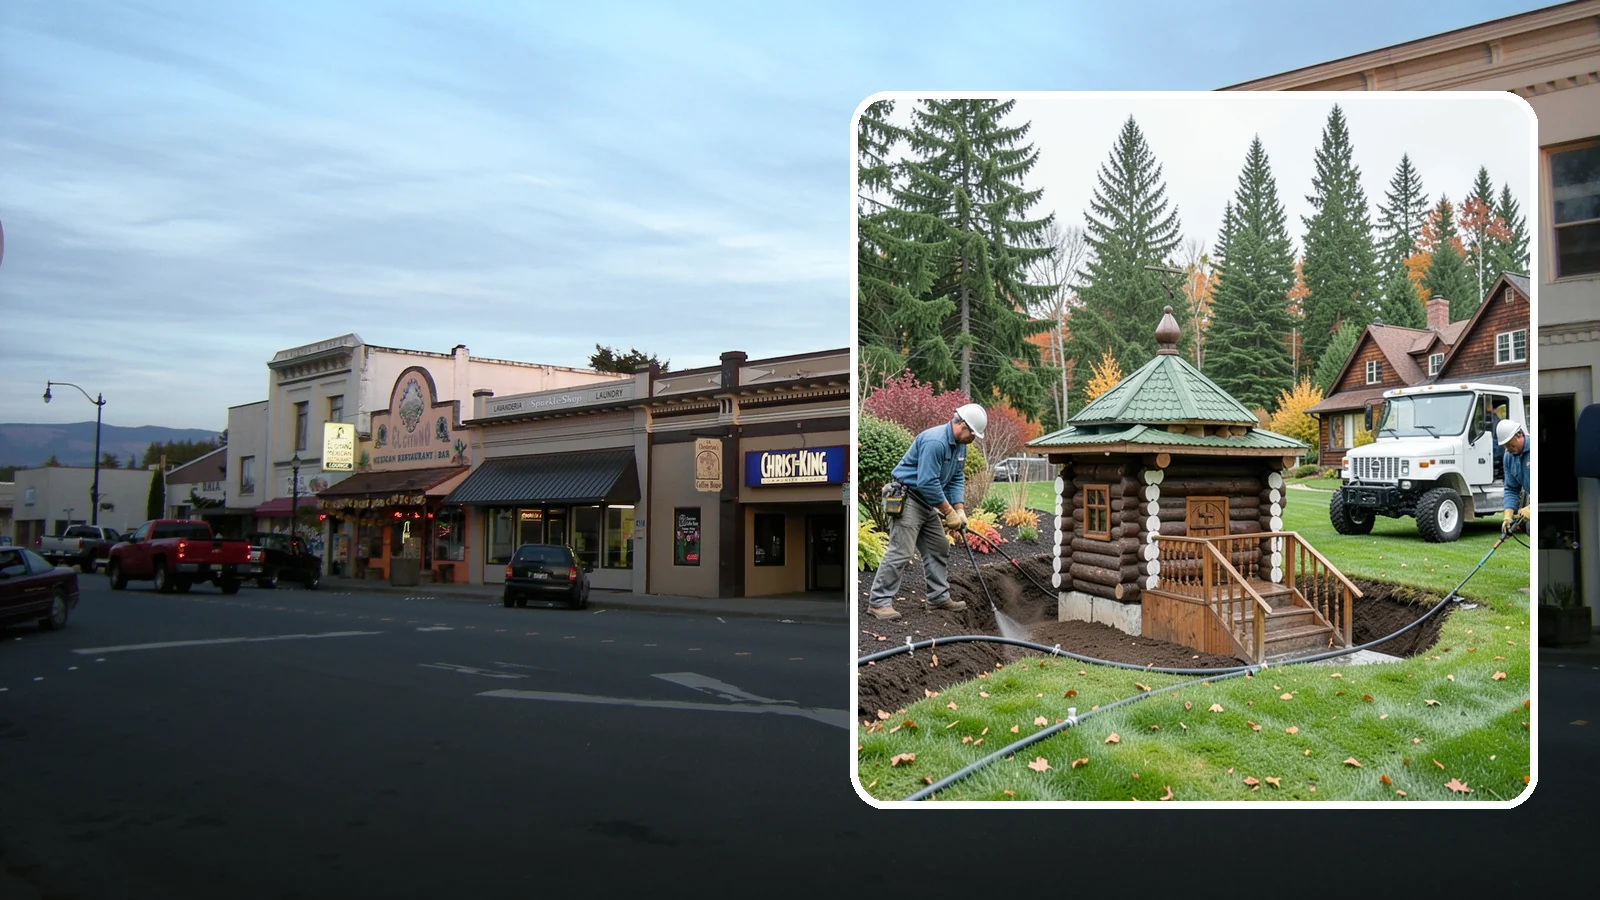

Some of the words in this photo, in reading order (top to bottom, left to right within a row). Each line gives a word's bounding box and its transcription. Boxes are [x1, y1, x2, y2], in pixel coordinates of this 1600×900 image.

[493, 402, 522, 412] LAVANDERIA
[531, 396, 561, 409] Sparkle
[561, 394, 583, 404] Shop
[595, 389, 623, 399] LAUNDRY
[373, 455, 396, 464] MEXICAN
[397, 451, 433, 462] RESTAURANT
[437, 450, 450, 459] BAR
[761, 452, 797, 477] CHRIST
[799, 450, 827, 475] KING
